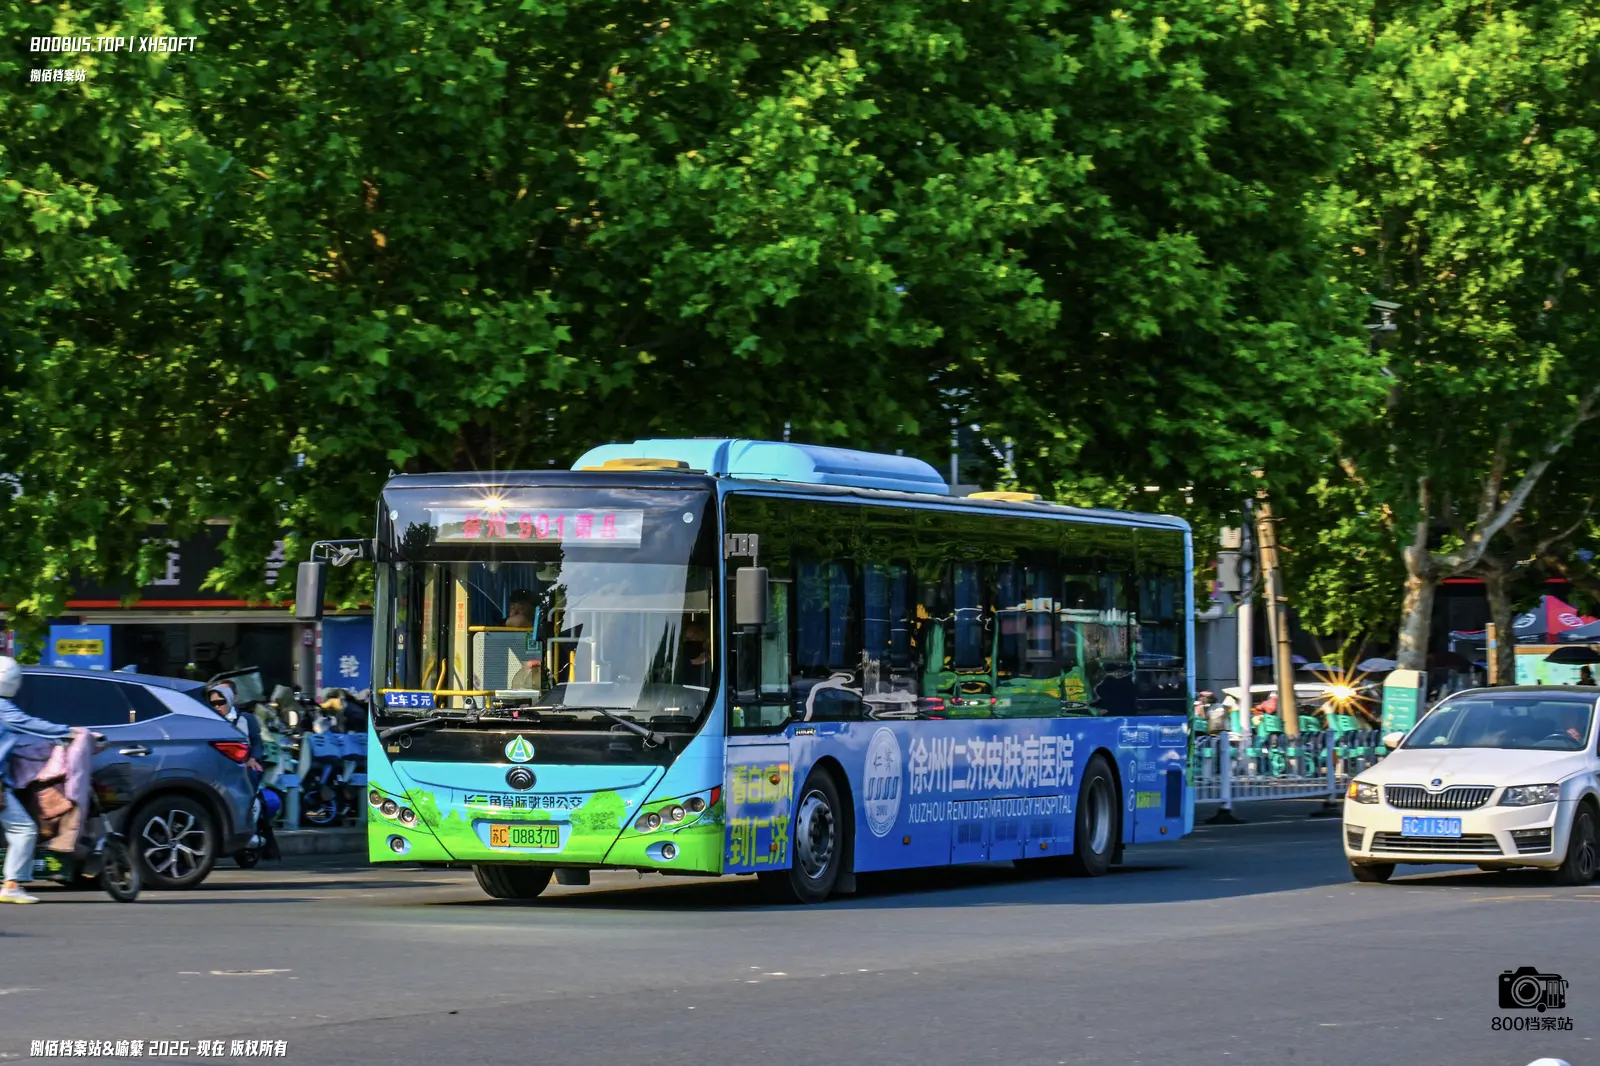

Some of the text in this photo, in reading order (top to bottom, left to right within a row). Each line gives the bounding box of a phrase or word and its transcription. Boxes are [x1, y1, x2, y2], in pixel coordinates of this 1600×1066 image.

[517, 513, 565, 540] 901
[908, 734, 1074, 795] 徐州仁济皮肤病医院
[463, 794, 583, 810] 长三角省际毗邻公交
[908, 794, 1073, 823] XUZHOU RENJI DERMATOLOGY HOSPITAL
[729, 814, 789, 867] 到仁济
